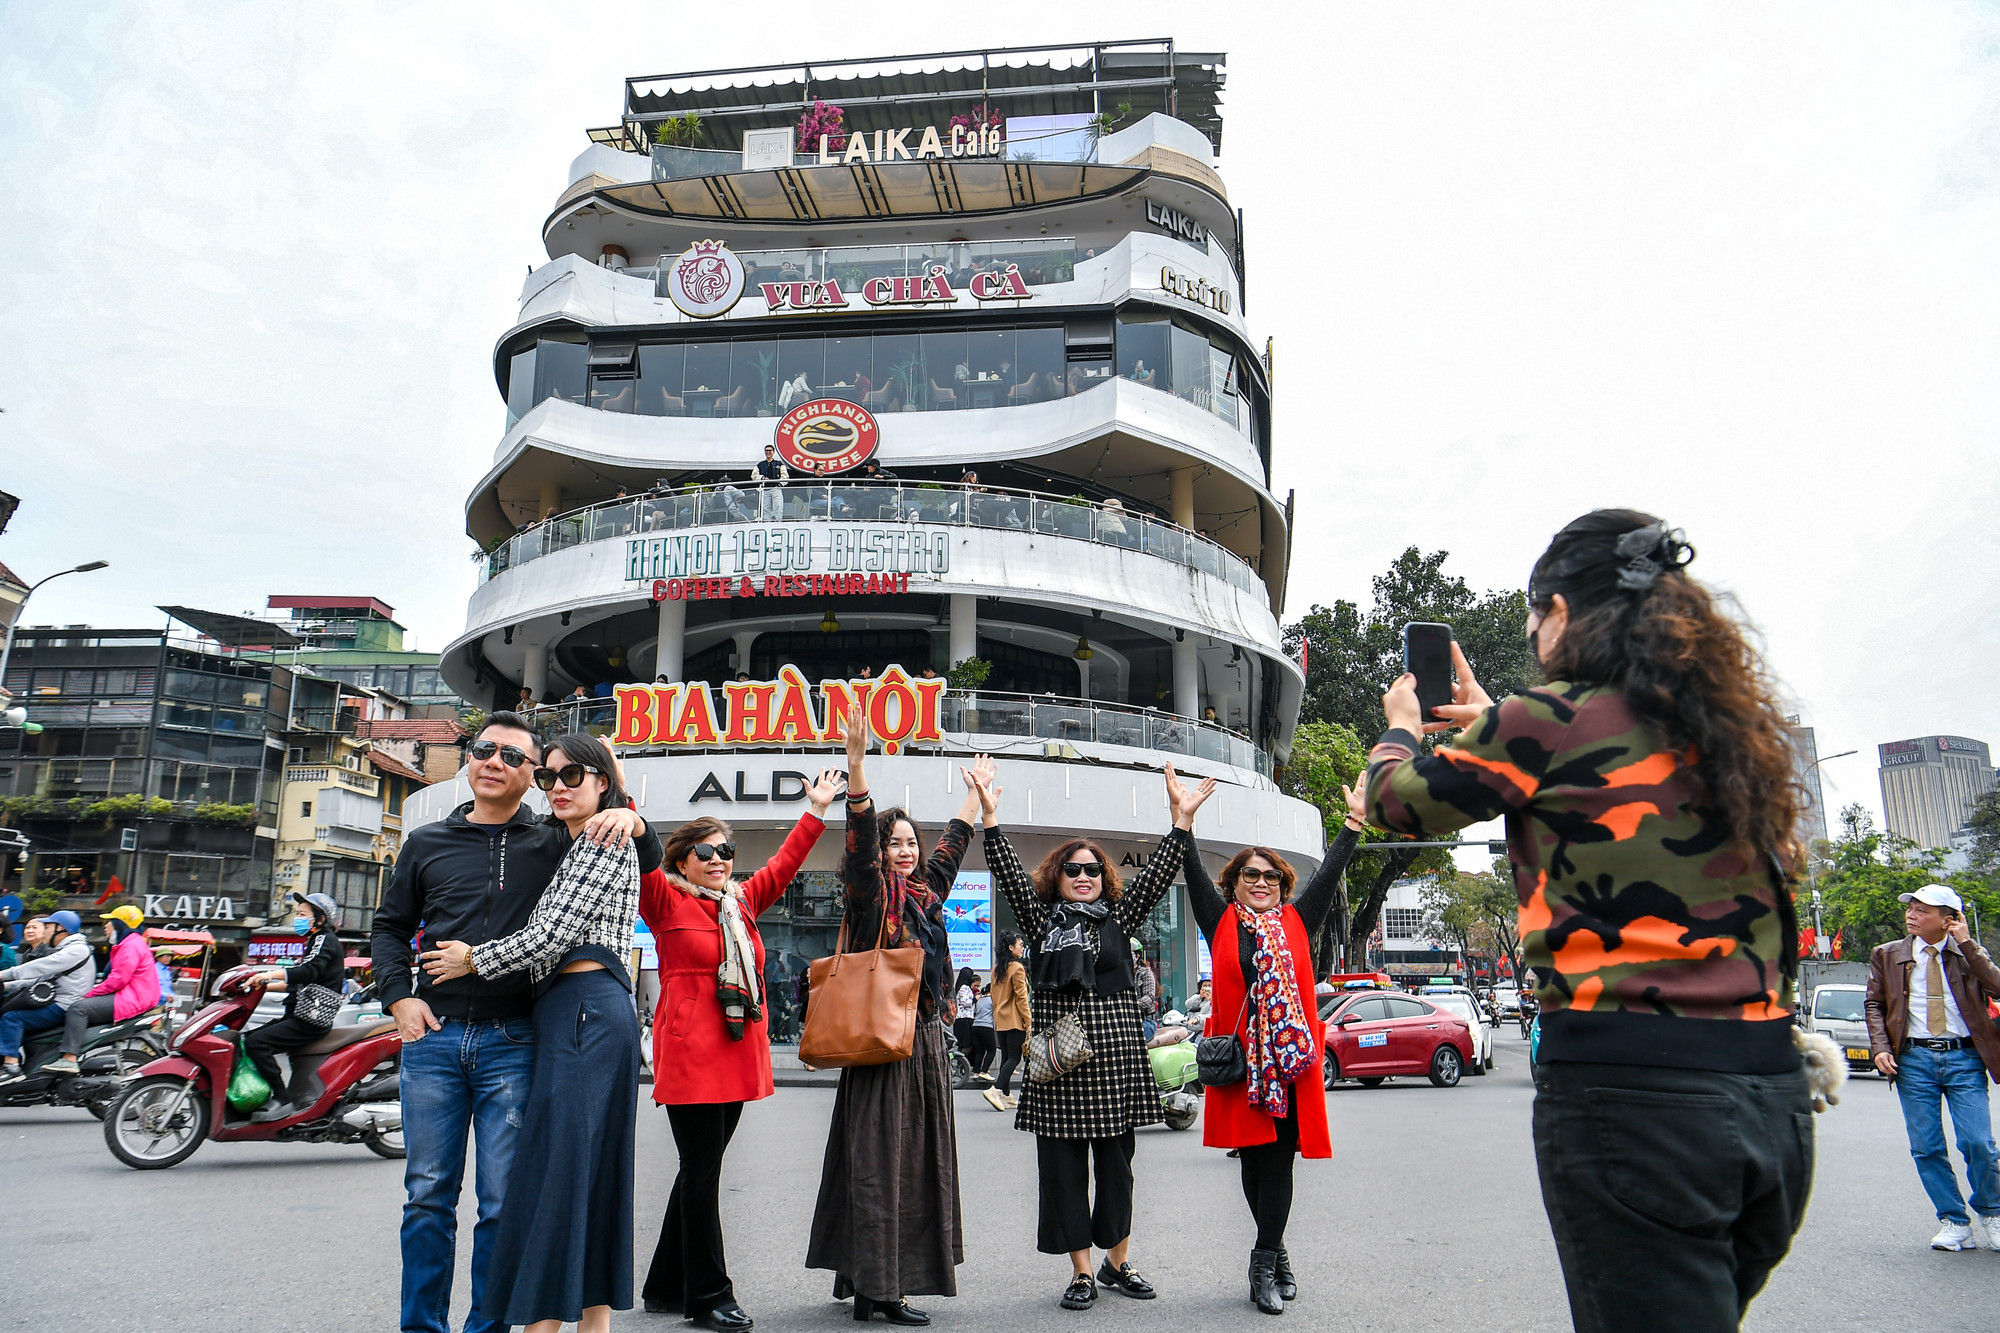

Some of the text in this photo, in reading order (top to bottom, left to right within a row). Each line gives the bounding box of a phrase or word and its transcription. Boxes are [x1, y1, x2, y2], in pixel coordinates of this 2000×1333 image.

[819, 122, 1004, 165] LAIKA Café
[1145, 198, 1206, 244] LAIKA
[758, 263, 1033, 311] VUA CHẢ CÁ
[1187, 277, 1209, 304] sở
[1211, 287, 1232, 314] 10
[780, 403, 873, 435] HIGHLANDS
[624, 528, 950, 581] HANOI 1930 BISTRO
[652, 572, 912, 602] COFFEE & RESTAURANT
[611, 667, 943, 756] BIA HÀ NỘI
[1884, 753, 1919, 766] GROUP
[500, 829, 508, 846] ORE
[1120, 852, 1153, 867] AL
[951, 882, 987, 891] obifone
[143, 894, 235, 921] KAFA
